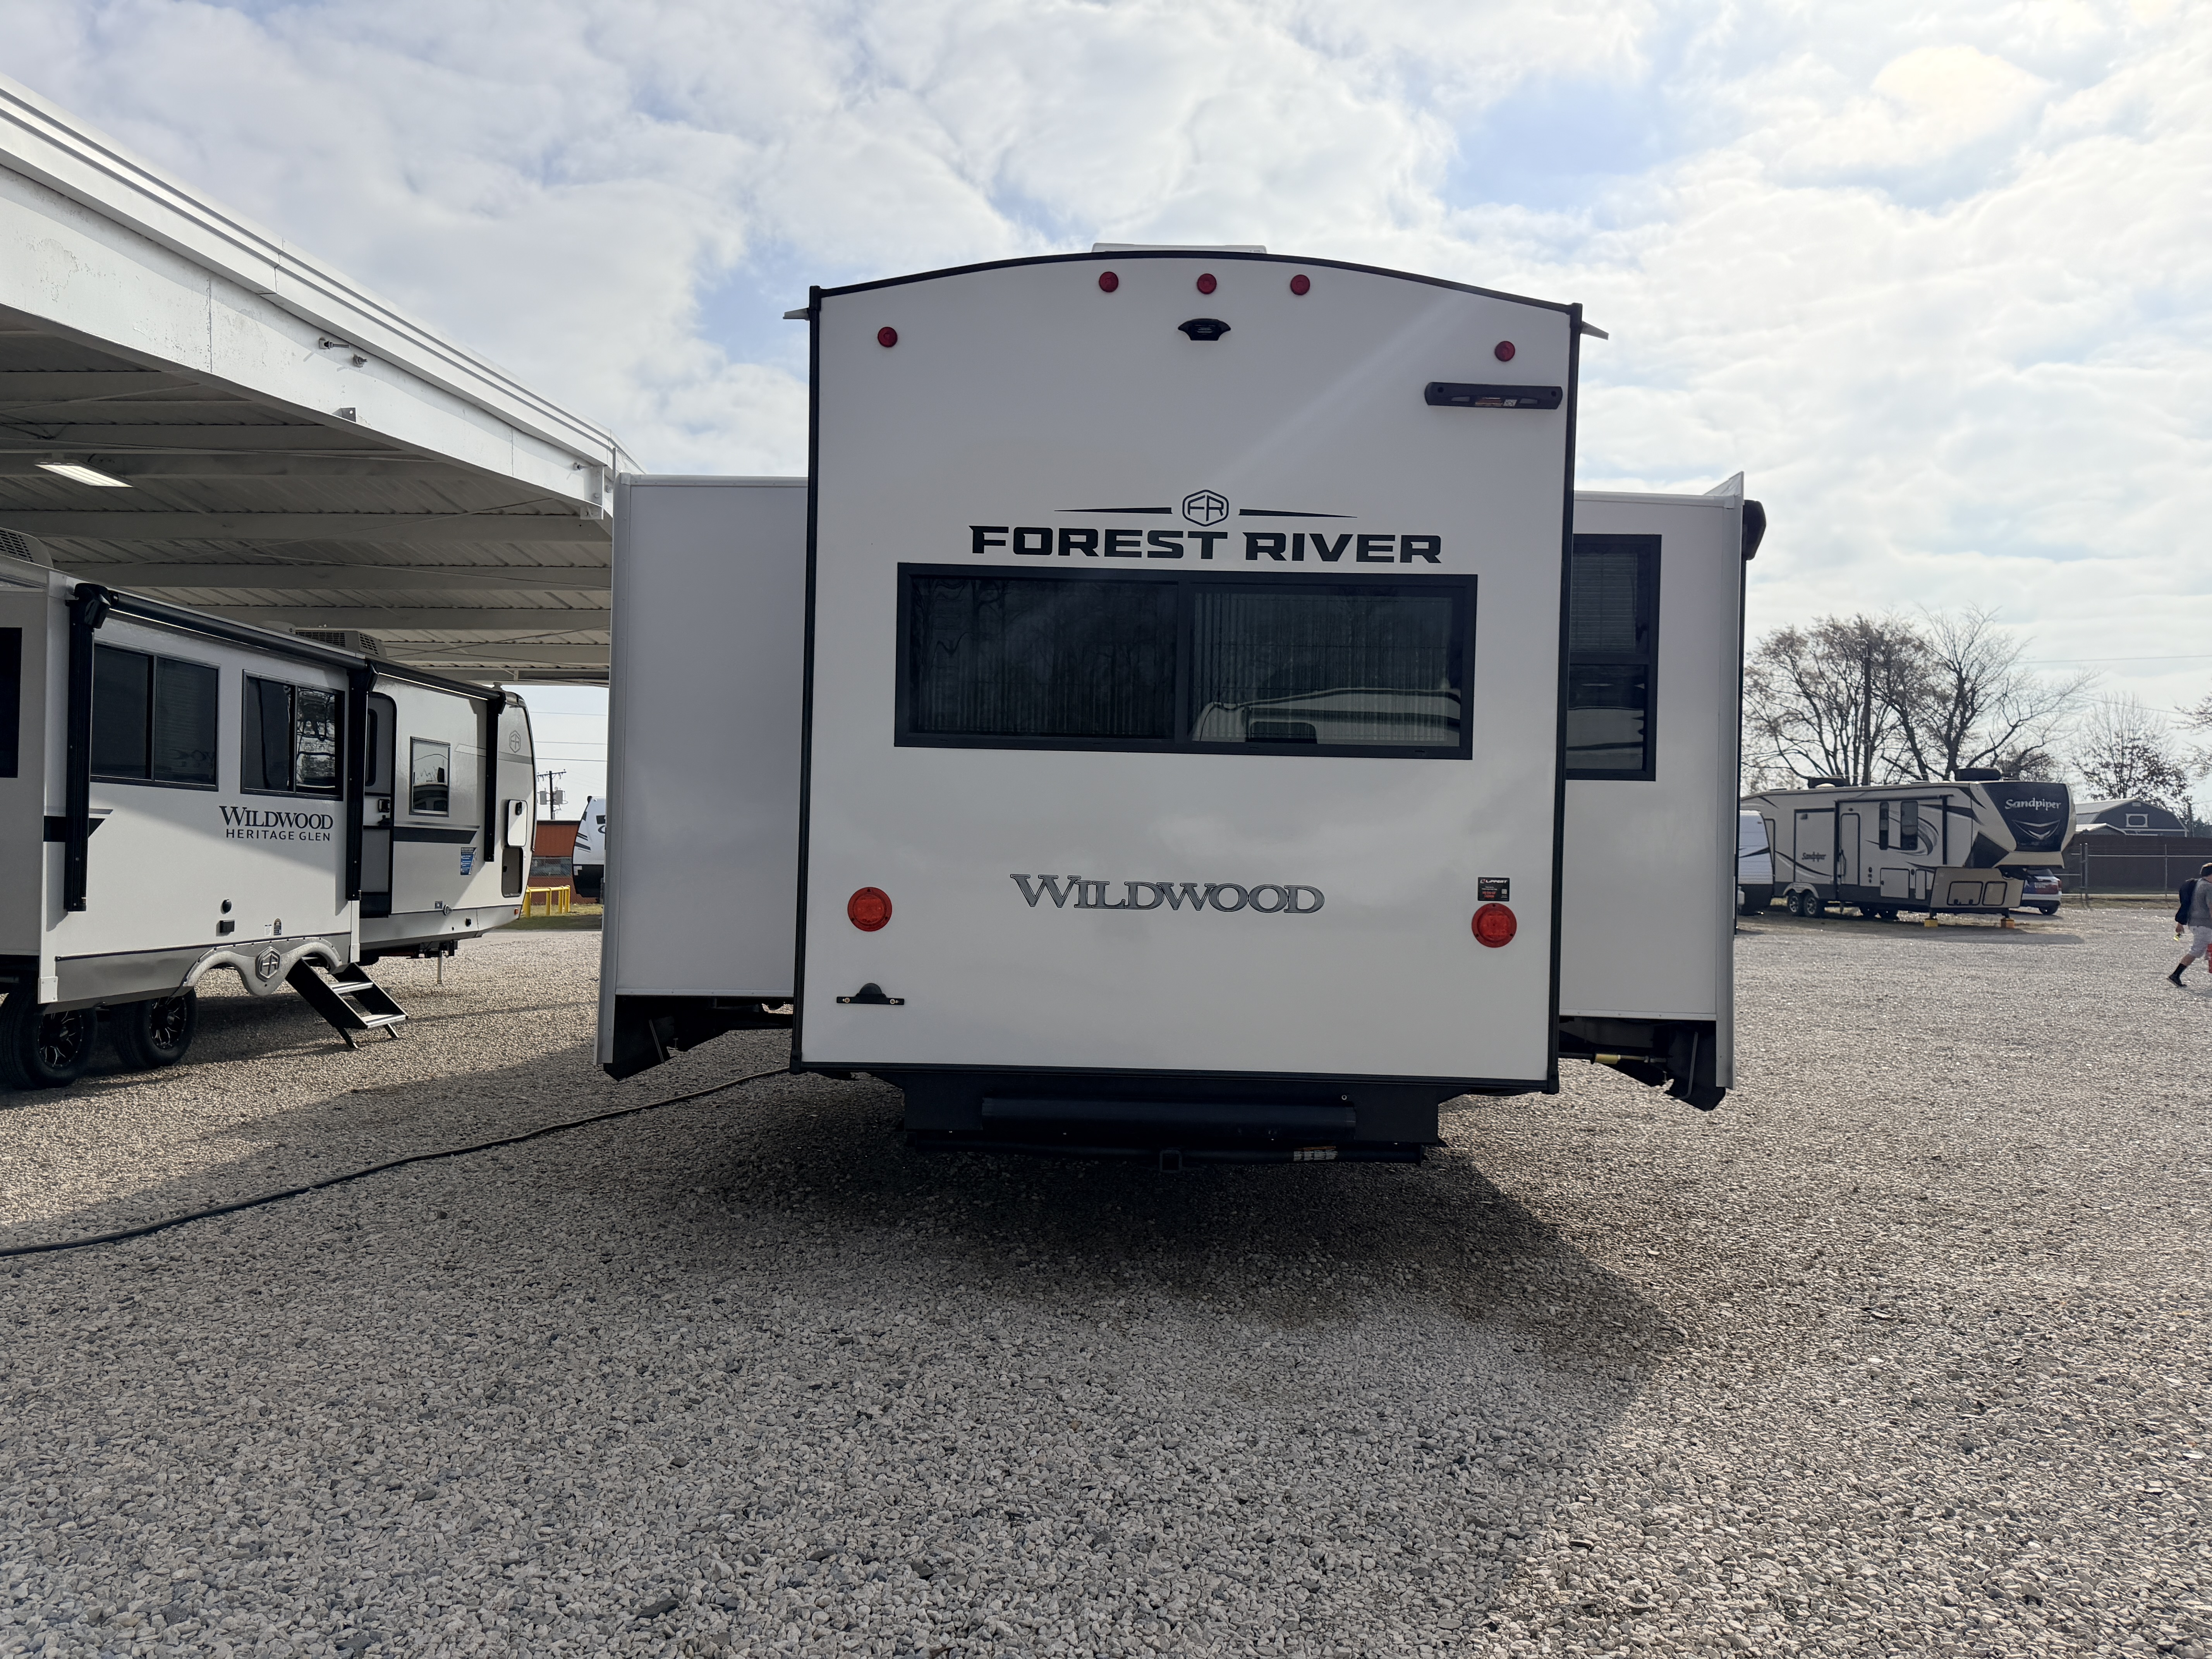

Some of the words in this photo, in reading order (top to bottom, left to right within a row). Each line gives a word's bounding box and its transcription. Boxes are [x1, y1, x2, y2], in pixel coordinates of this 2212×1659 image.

[969, 526, 1228, 560] FOREST
[1242, 532, 1441, 563] RIVER
[2005, 797, 2062, 811] Sandpiper
[219, 805, 333, 830] WILDWOOD
[226, 828, 295, 840] HERITAGE
[299, 831, 330, 842] GLEN
[1010, 874, 1325, 914] WILDWOOD
